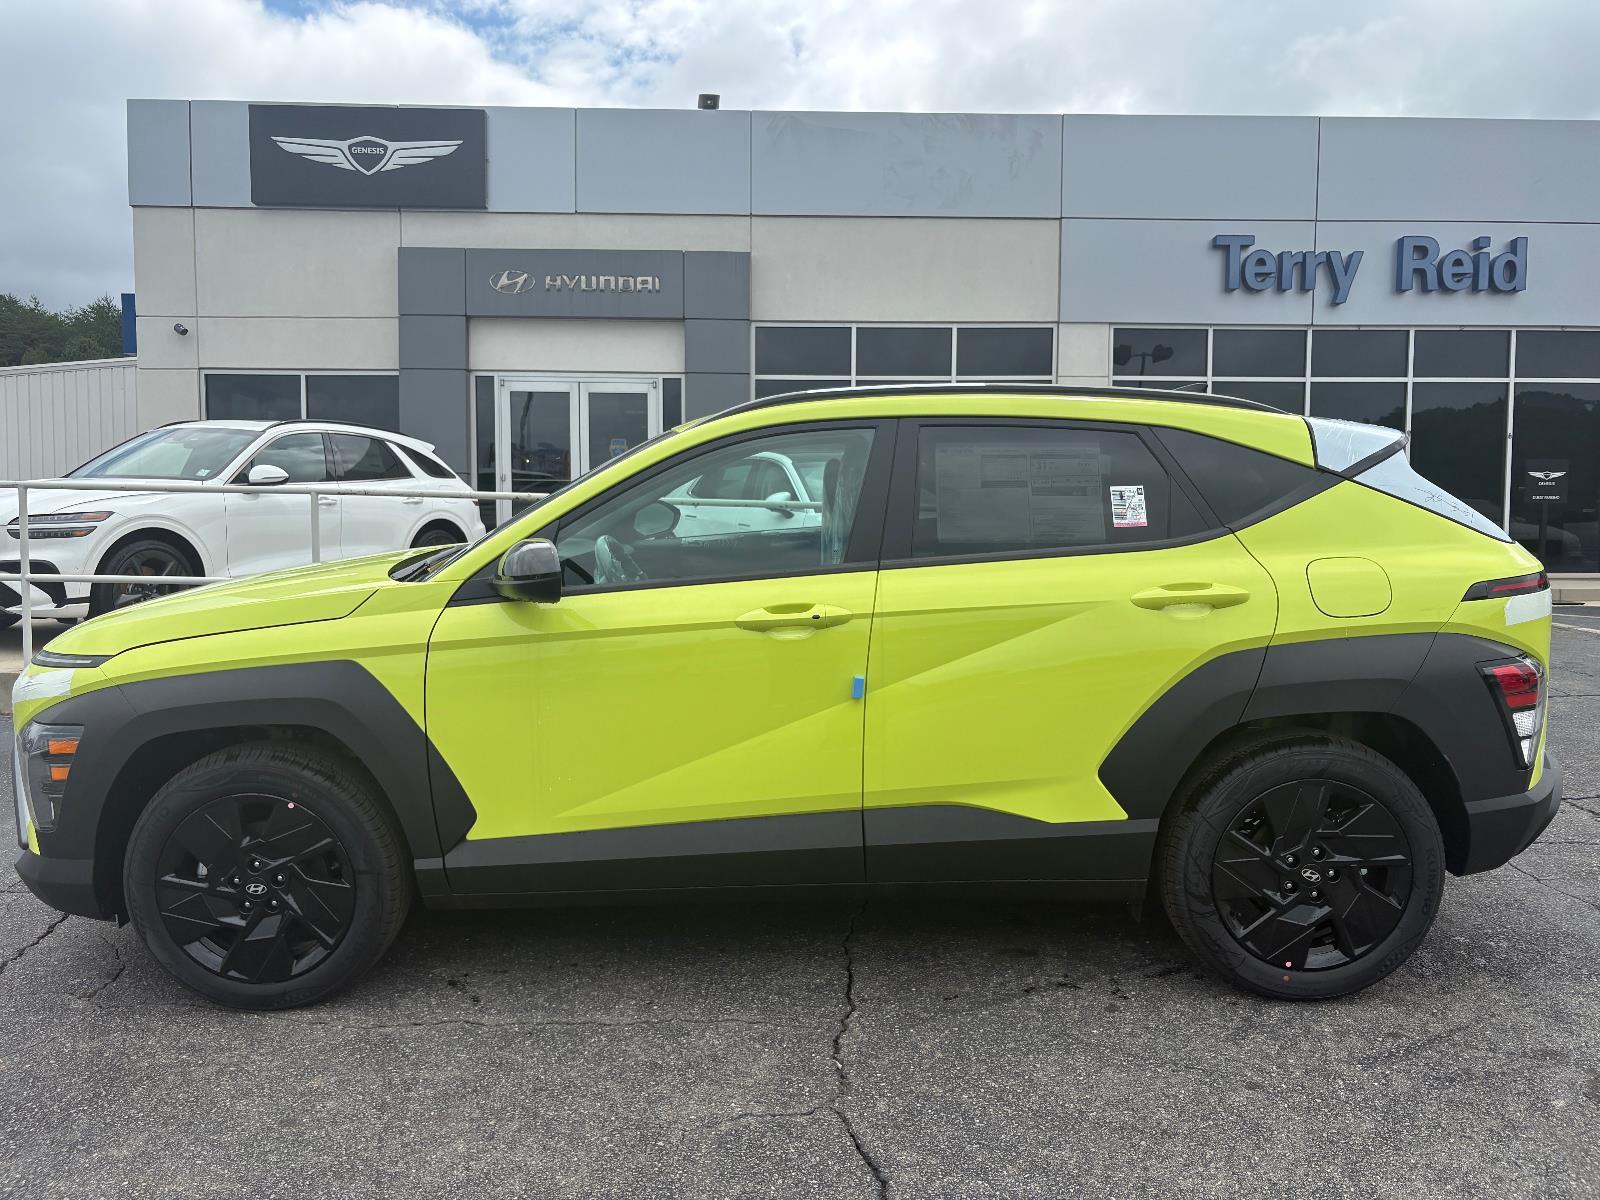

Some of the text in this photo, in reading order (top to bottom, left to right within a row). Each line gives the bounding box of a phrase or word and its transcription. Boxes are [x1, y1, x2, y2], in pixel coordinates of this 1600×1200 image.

[351, 146, 385, 154] GENESIS
[1212, 234, 1529, 306] Terry Reid
[545, 274, 661, 293] HYUNDAI
